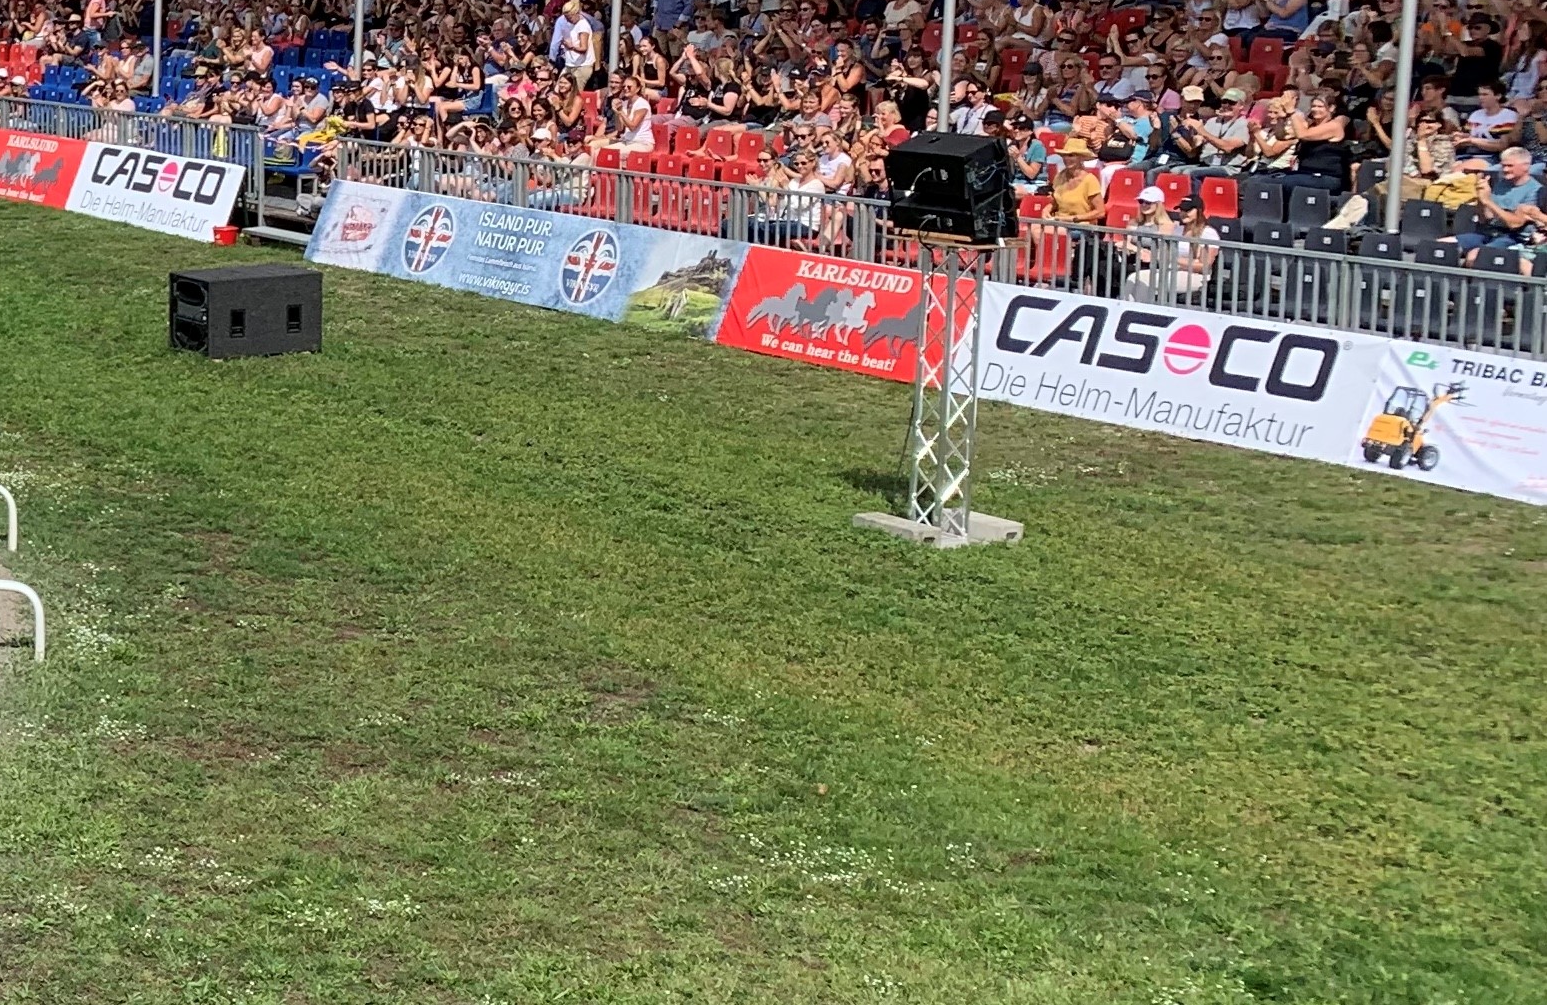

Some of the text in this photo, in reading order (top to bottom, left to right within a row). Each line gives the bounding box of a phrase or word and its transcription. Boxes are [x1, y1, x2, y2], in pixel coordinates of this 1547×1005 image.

[7, 134, 59, 153] KARLSLUND
[80, 190, 208, 234] Die Helm-Manufaktur
[478, 211, 553, 237] ISLAND PUR.
[474, 231, 545, 256] NATUR PUR.
[458, 272, 532, 295] www.vikingyr.is
[796, 259, 914, 294] KARLSLUND
[761, 333, 897, 372] We can hear the beat!
[1452, 359, 1524, 384] TRIBAC
[980, 363, 1314, 450] Die Helm-Manufaktur
